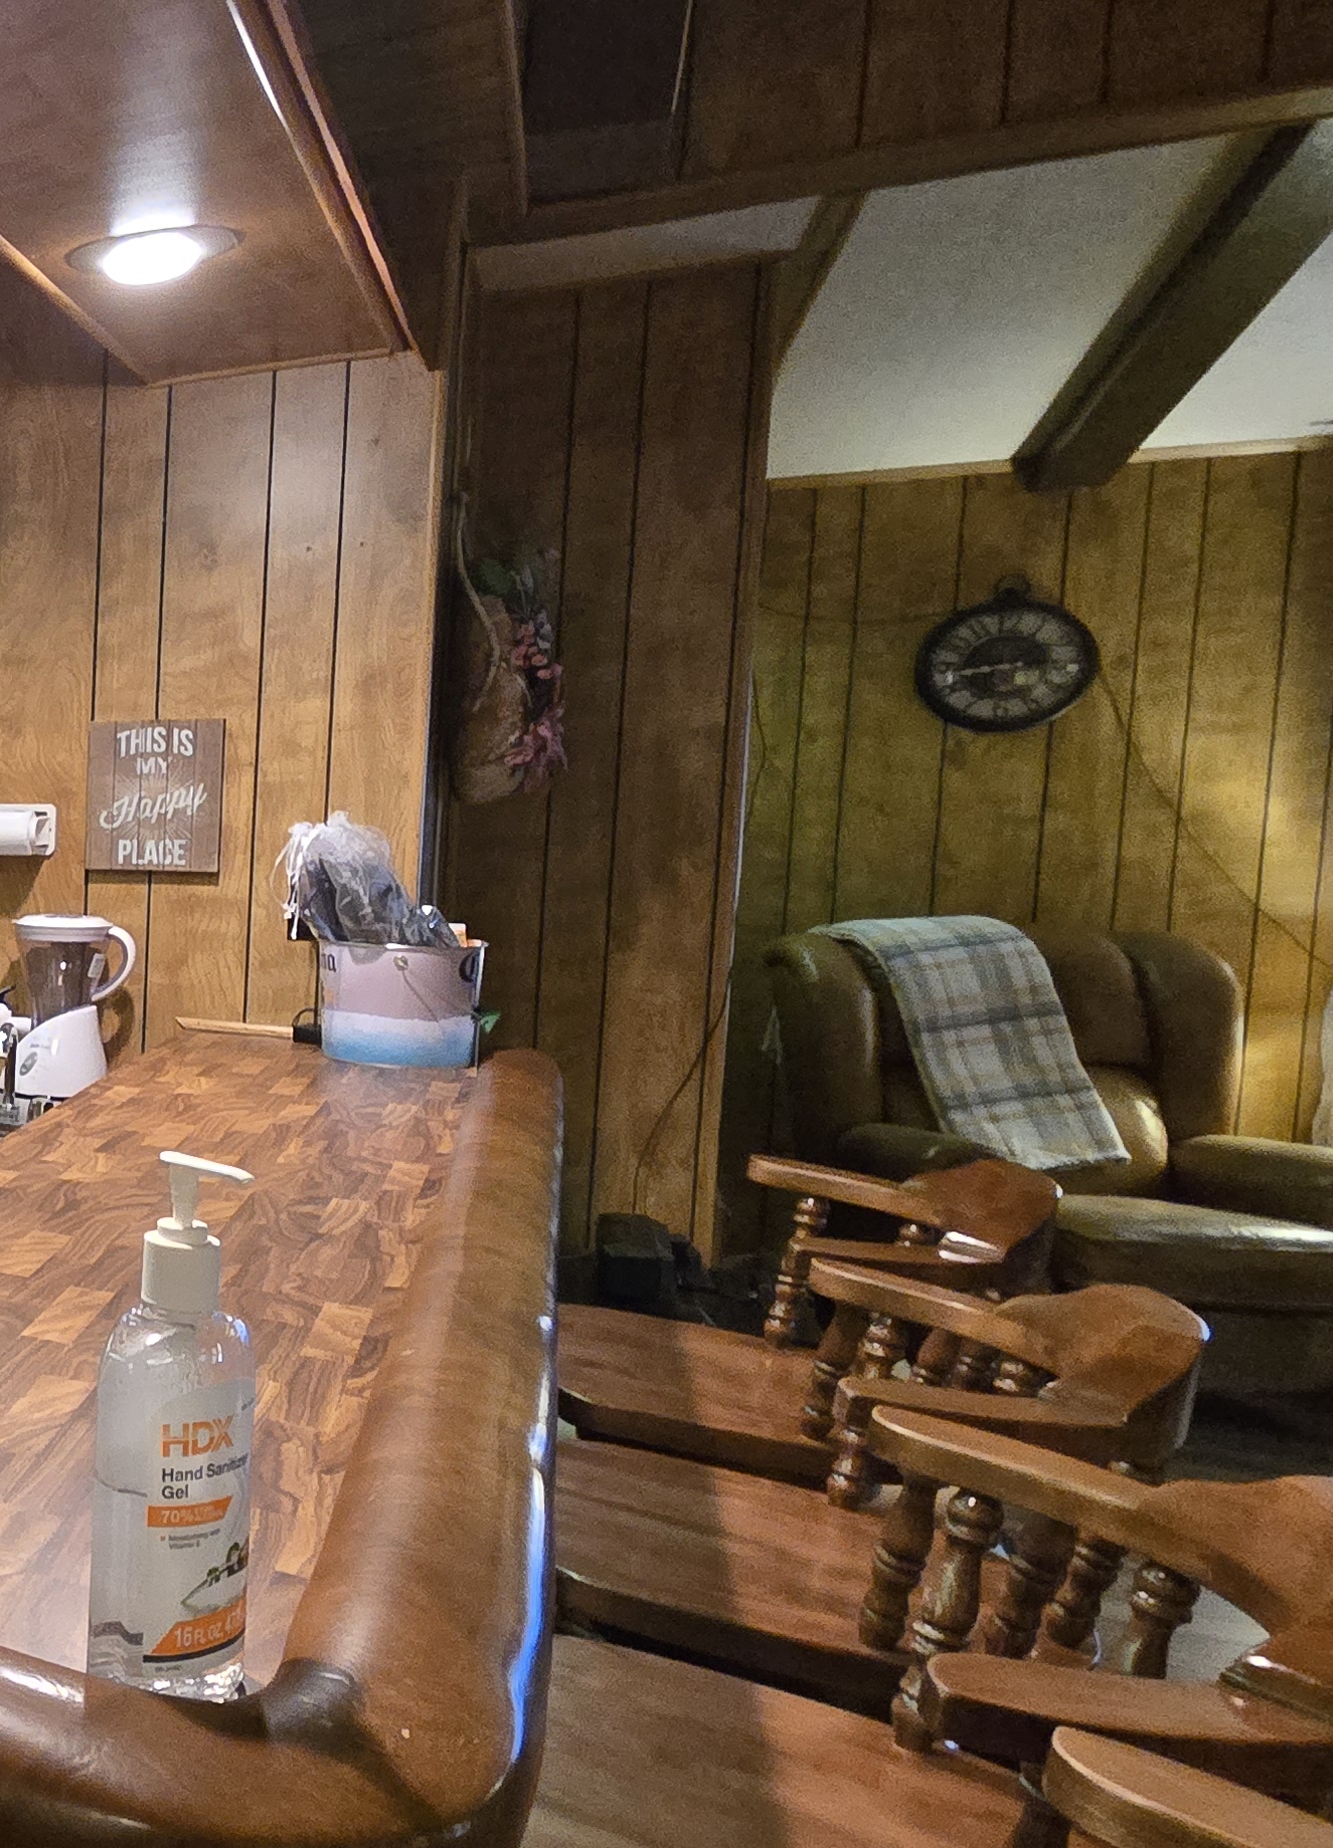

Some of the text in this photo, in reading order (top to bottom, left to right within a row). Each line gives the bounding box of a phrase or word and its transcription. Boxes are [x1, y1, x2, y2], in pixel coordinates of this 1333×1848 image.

[117, 726, 194, 758] THIS IS
[136, 757, 170, 775] MY
[99, 782, 208, 830] Happy
[117, 839, 187, 866] PLACE
[161, 1415, 233, 1457] HDX
[161, 1466, 204, 1482] Hand
[161, 1484, 189, 1499] Gel
